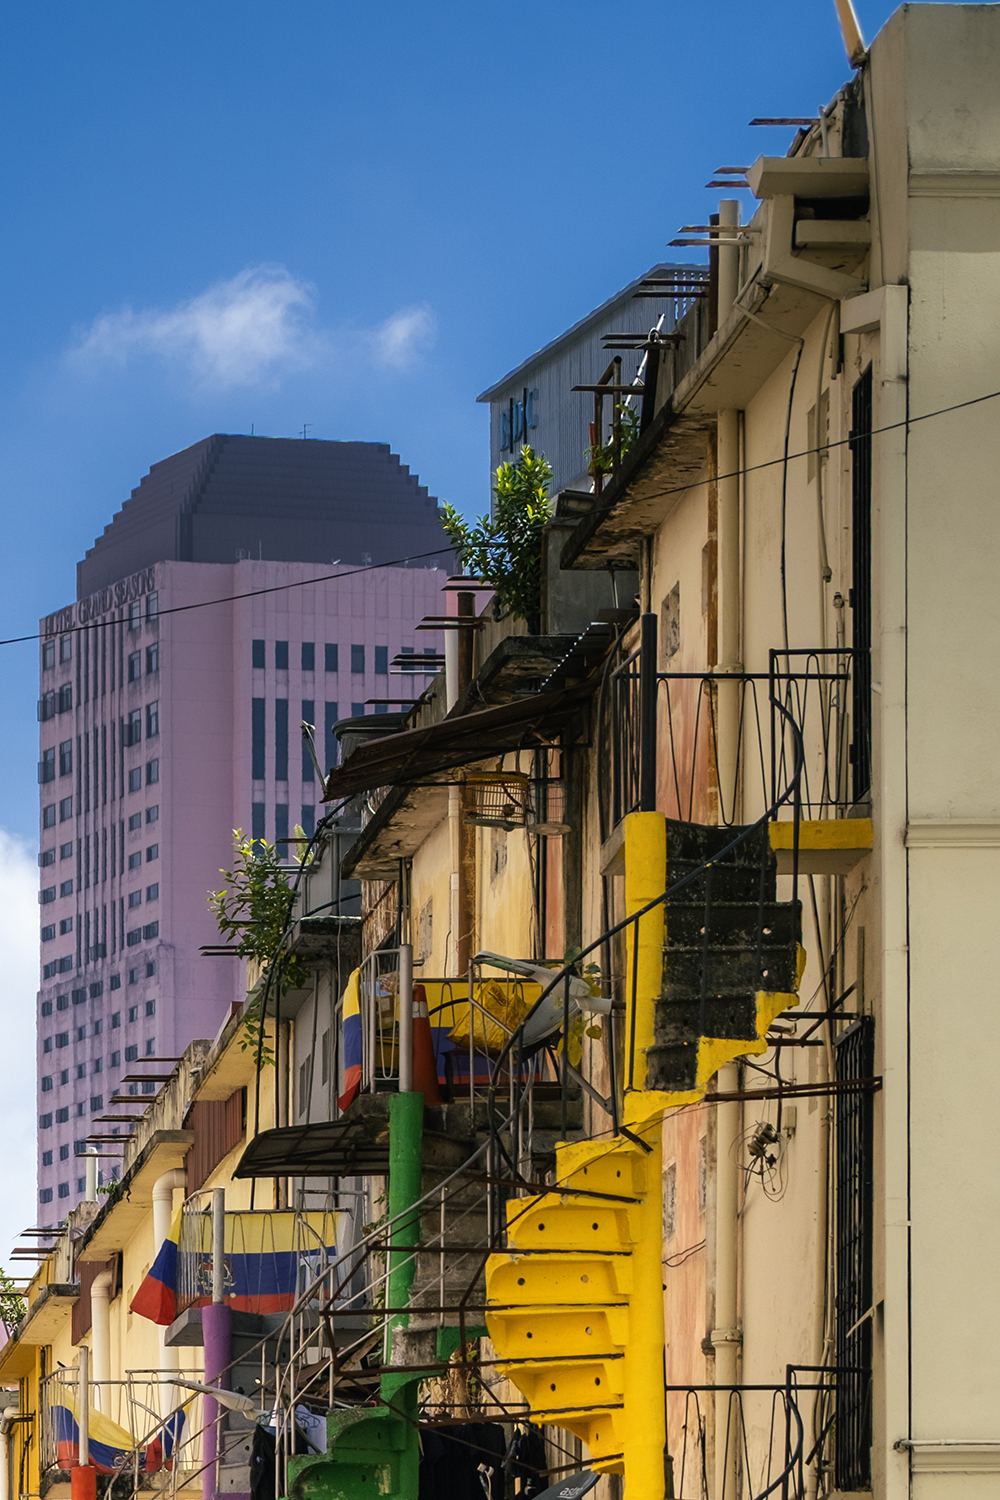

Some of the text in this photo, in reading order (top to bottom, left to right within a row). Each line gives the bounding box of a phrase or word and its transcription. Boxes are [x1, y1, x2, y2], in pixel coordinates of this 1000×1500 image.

[45, 567, 156, 640] HOTEL GRAND SEASONS
